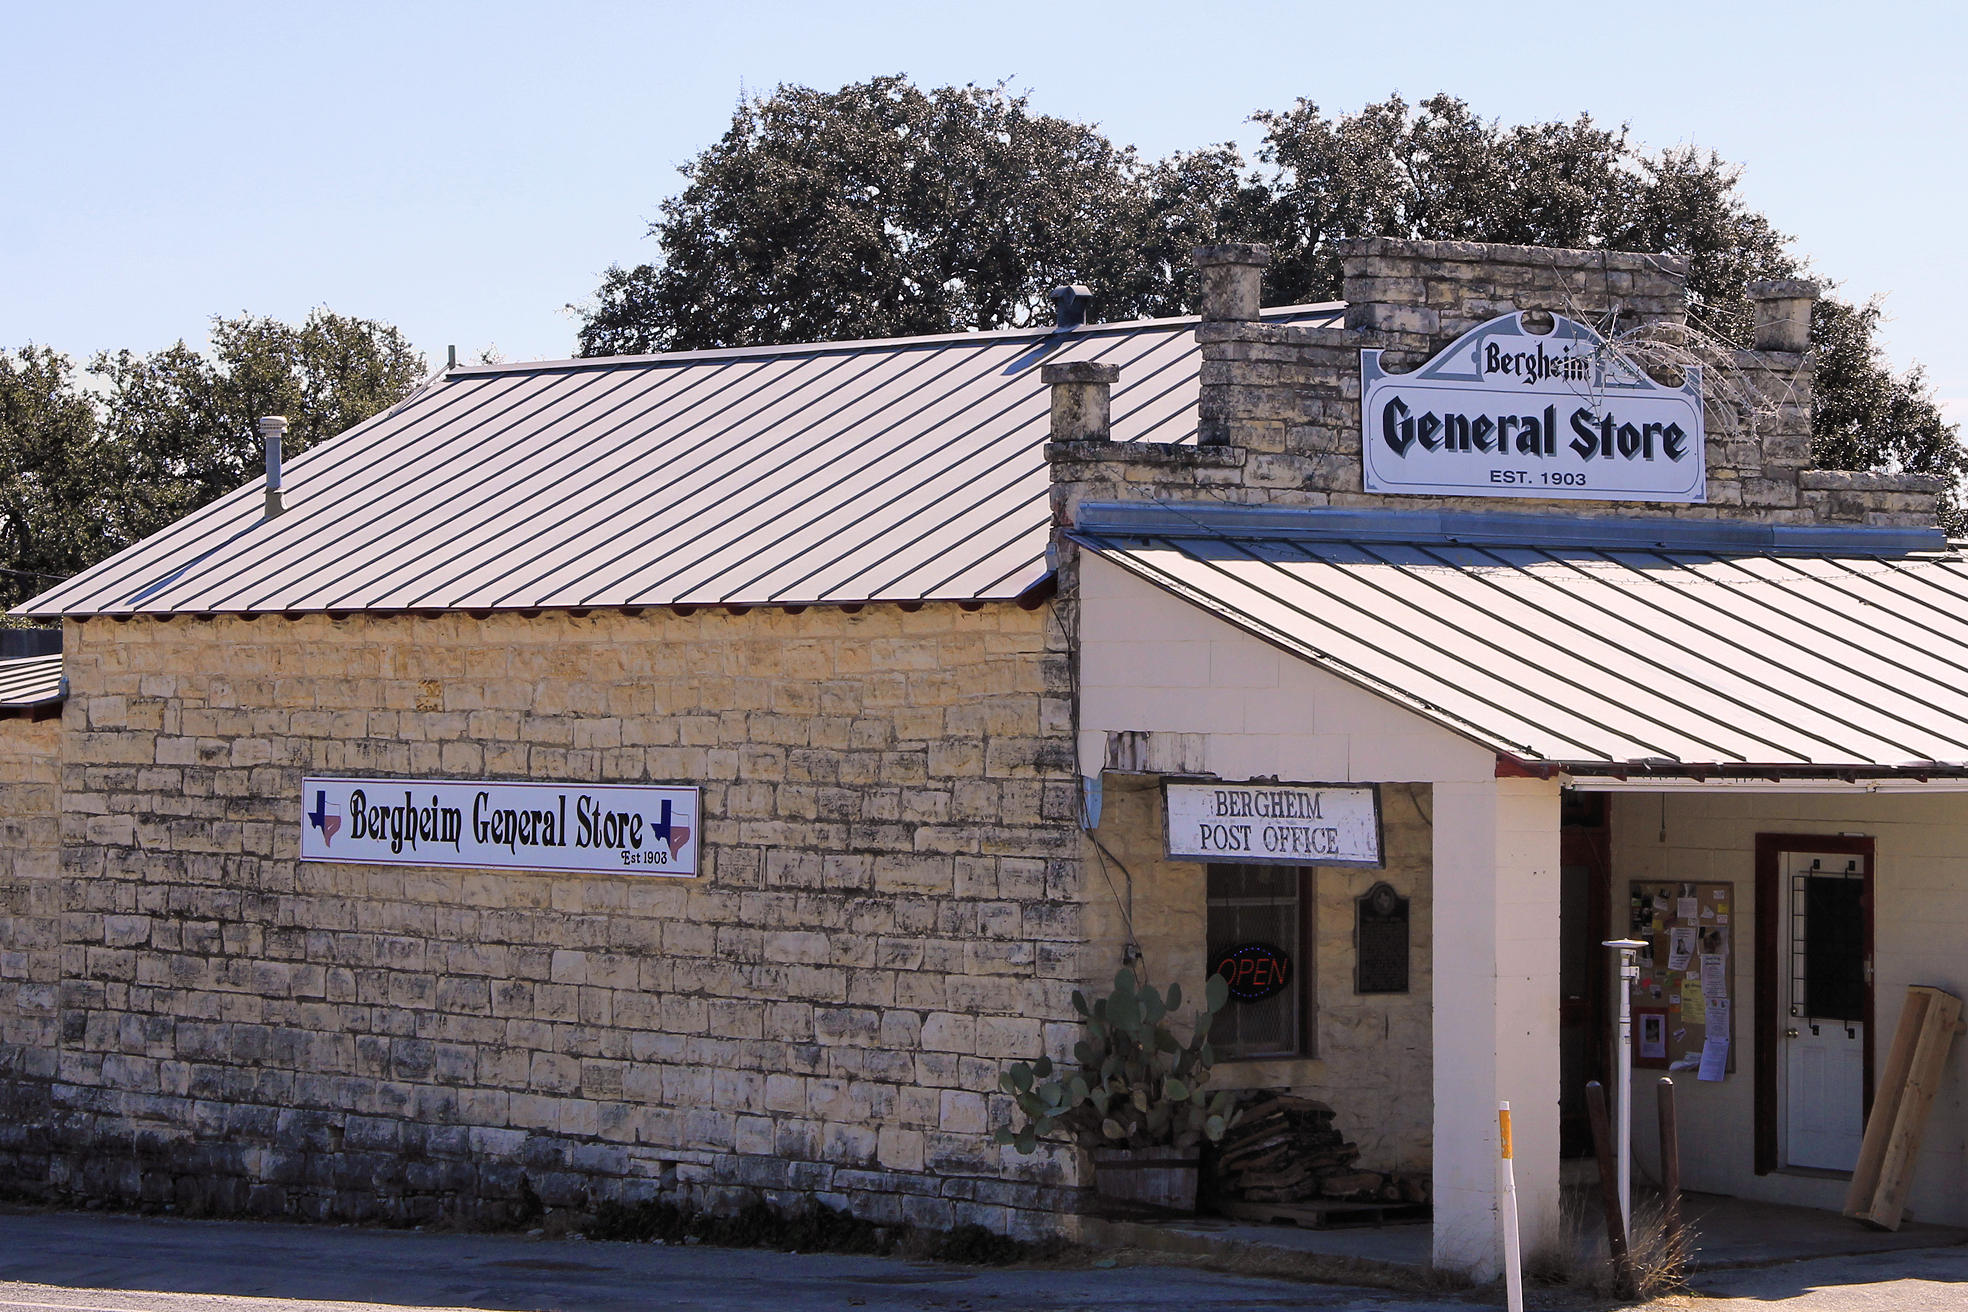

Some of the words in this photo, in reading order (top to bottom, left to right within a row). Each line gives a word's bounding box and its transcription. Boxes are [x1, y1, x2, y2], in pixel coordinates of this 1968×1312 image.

[1484, 341, 1591, 386] Bergheim
[1382, 396, 1557, 459] General
[1569, 407, 1689, 463] Store
[1490, 470, 1533, 485] EST.
[1541, 472, 1587, 486] 1903
[1214, 790, 1324, 820] BERGHEIM
[350, 789, 462, 854] Bergheim
[472, 791, 567, 855] General
[575, 795, 643, 849] Store
[1199, 824, 1252, 851] POST
[1263, 826, 1339, 854] OFFICE
[621, 850, 641, 865] Est
[643, 851, 668, 865] 1903
[1216, 958, 1288, 985] OPEN
